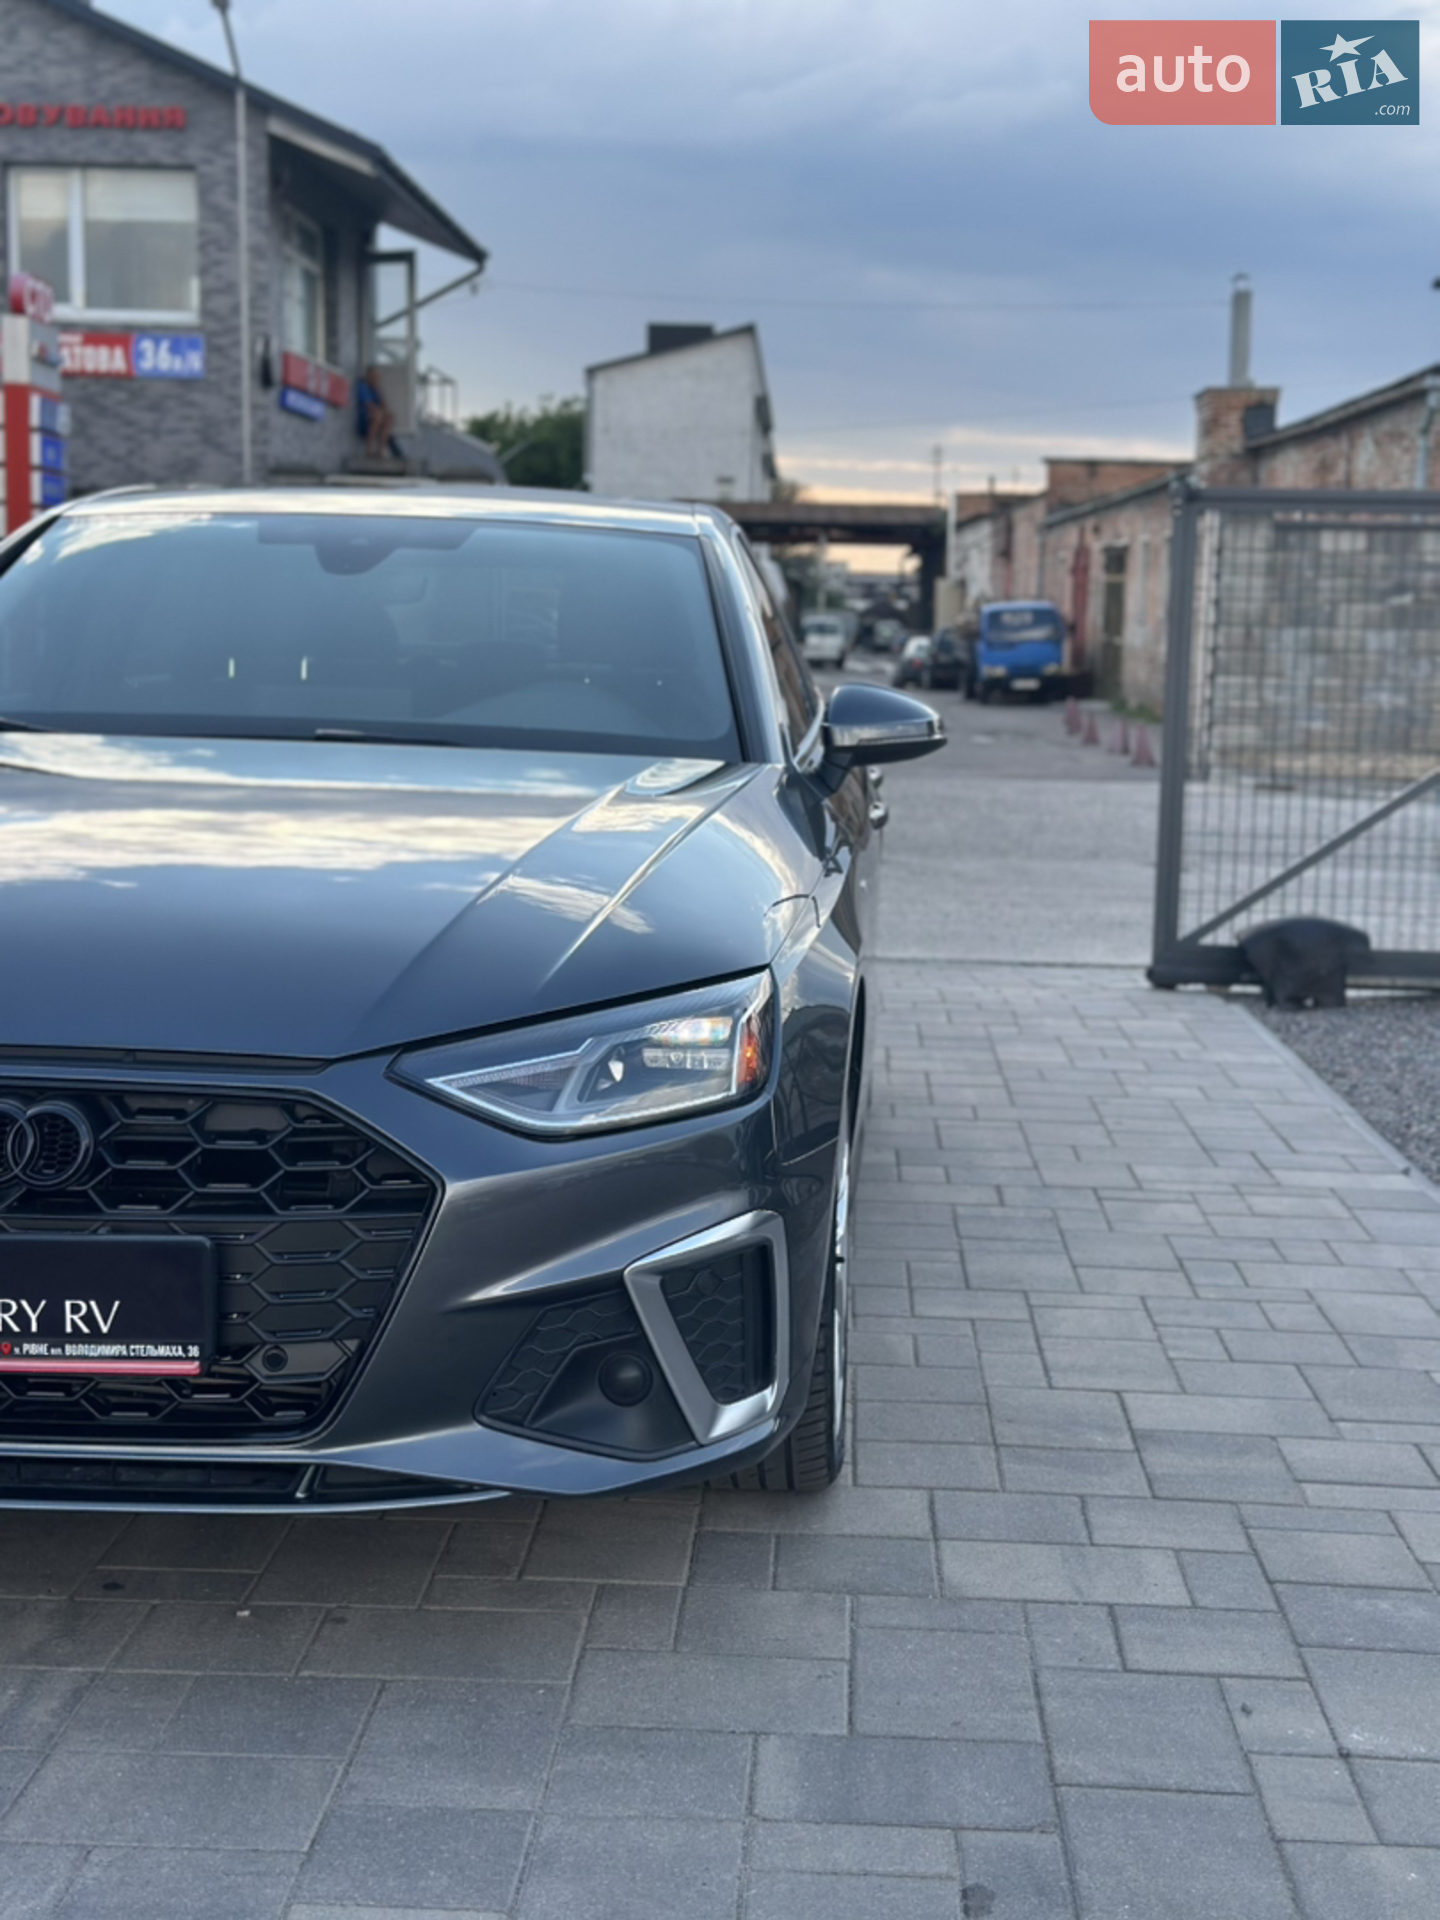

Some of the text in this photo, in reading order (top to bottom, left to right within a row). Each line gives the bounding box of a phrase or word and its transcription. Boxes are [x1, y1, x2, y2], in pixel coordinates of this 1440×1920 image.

[0, 1299, 120, 1334] RY RV
[22, 1343, 48, 1355] РІВНЕ
[65, 1343, 128, 1357] ВОЛОДИМИРА
